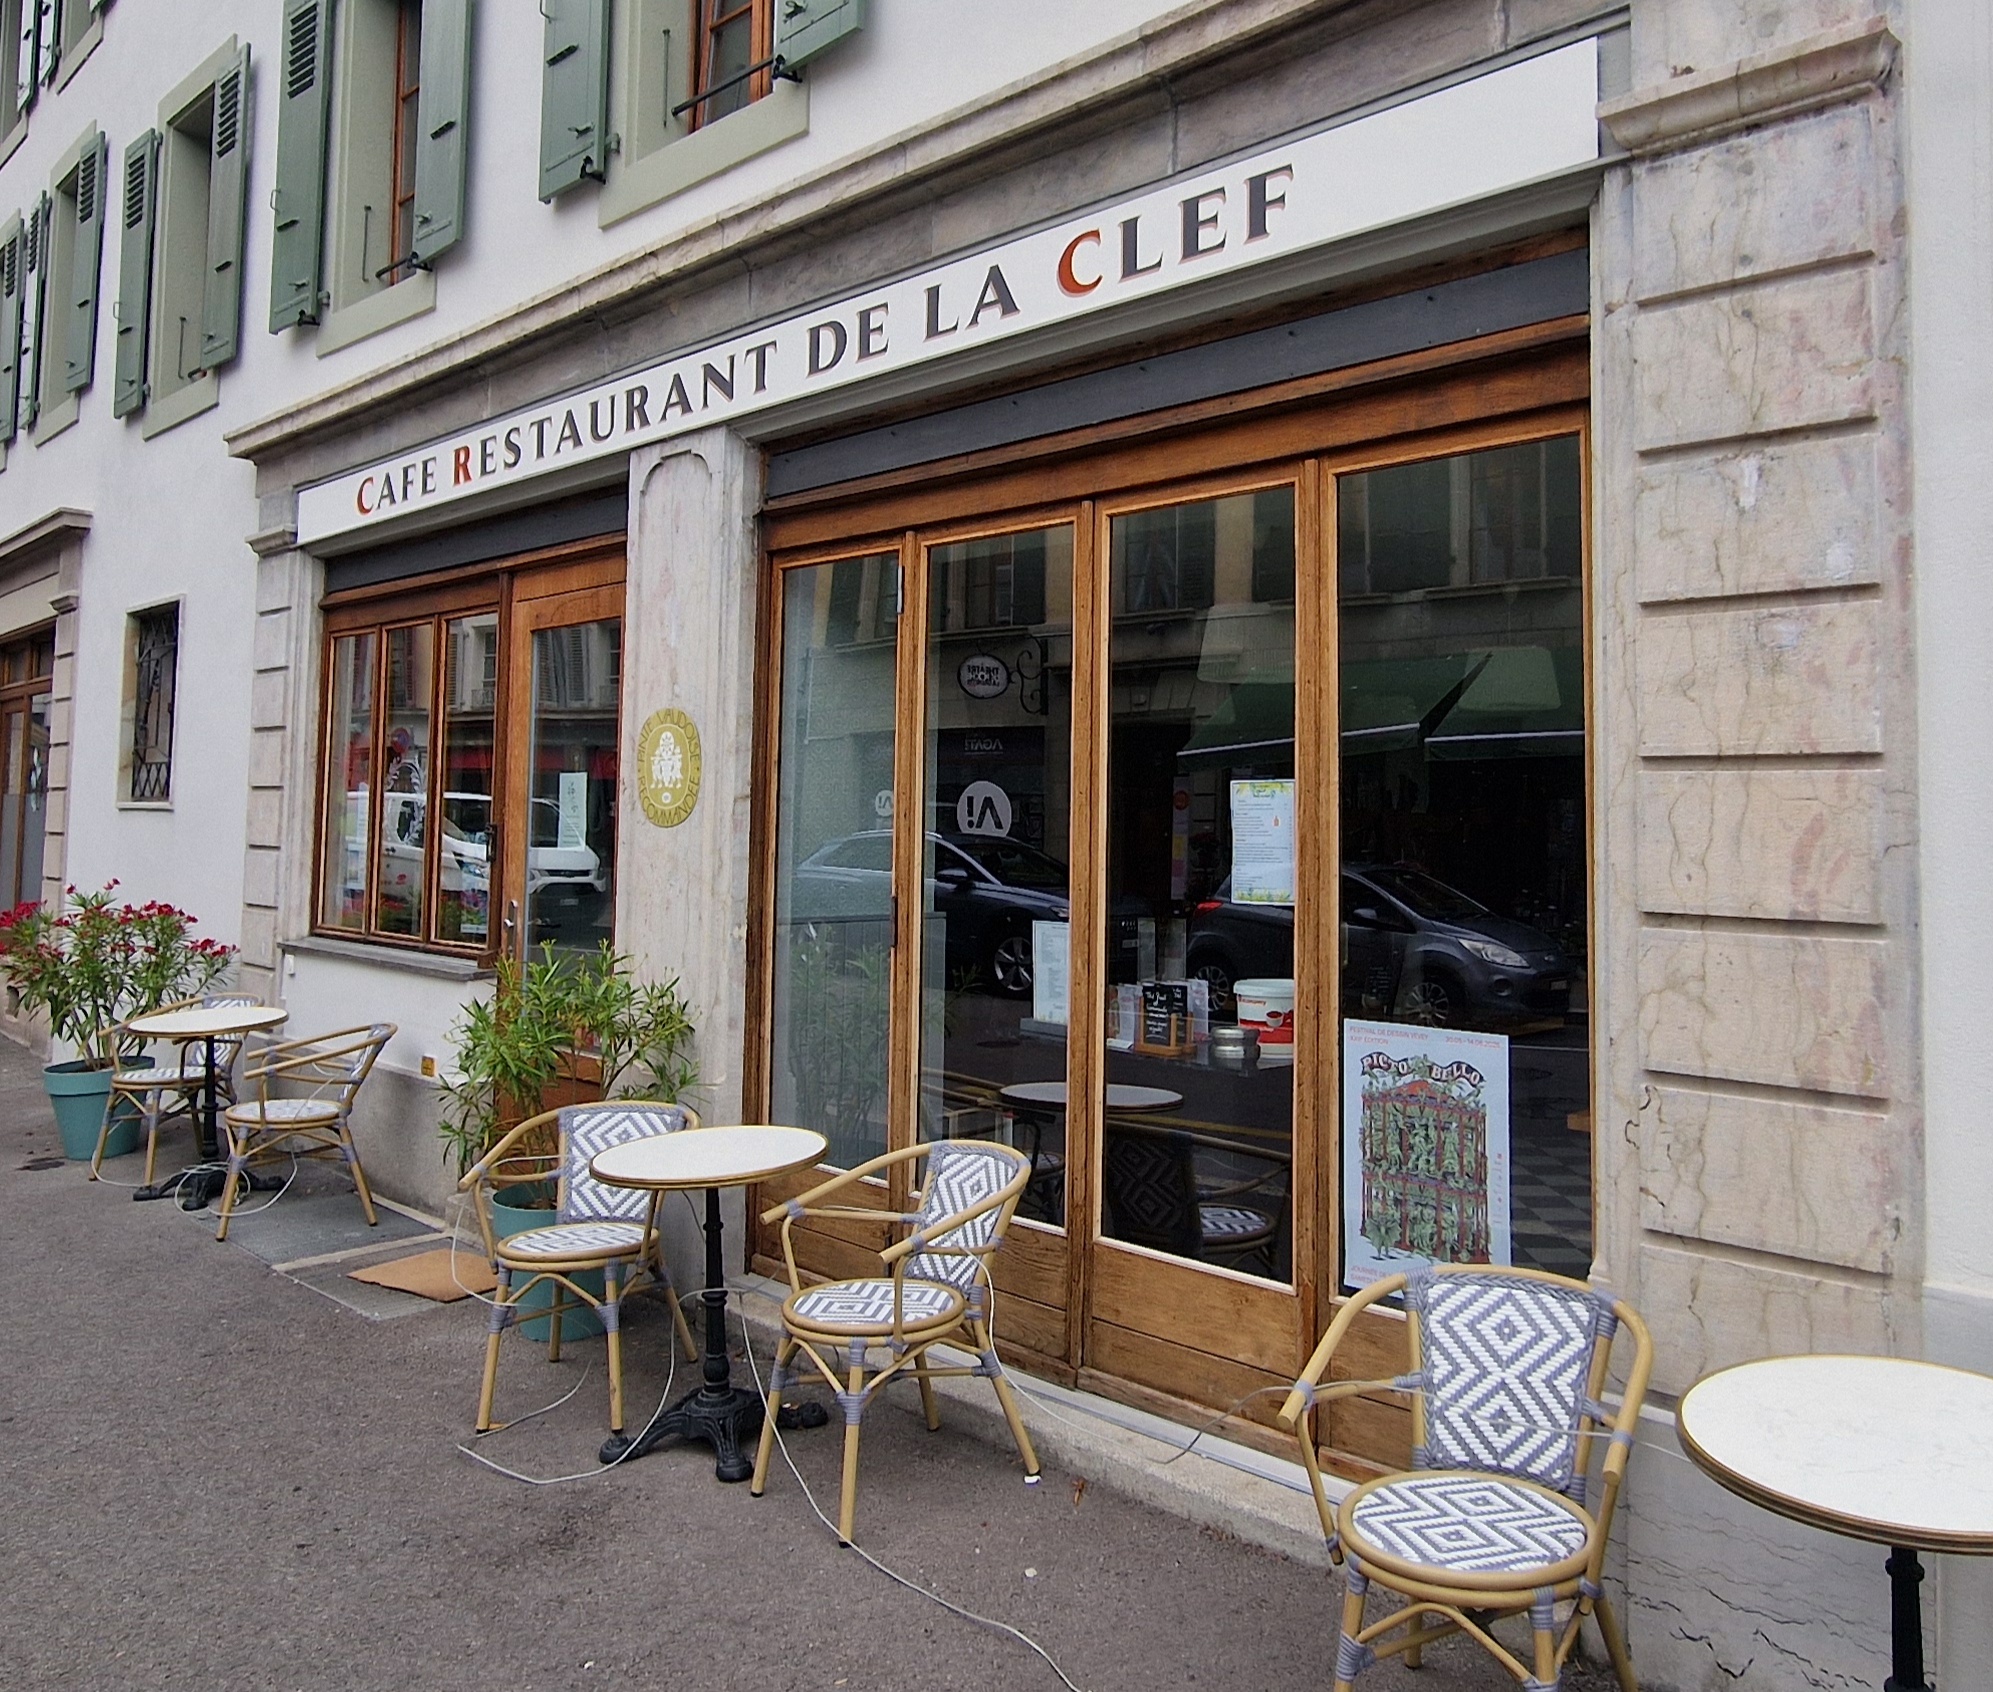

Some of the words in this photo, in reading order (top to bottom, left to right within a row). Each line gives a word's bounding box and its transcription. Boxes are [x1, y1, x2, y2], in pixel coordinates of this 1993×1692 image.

[356, 456, 438, 516] CAFE
[452, 340, 778, 487] RESTAURANT
[805, 302, 890, 378] DE
[922, 264, 1021, 343] LA
[1056, 163, 1294, 298] CLEF
[656, 707, 701, 763] VAUDOISE
[1349, 1026, 1376, 1036] FESTIVAL
[1363, 1052, 1409, 1075] PICTO
[1431, 1062, 1481, 1086] BELLO
